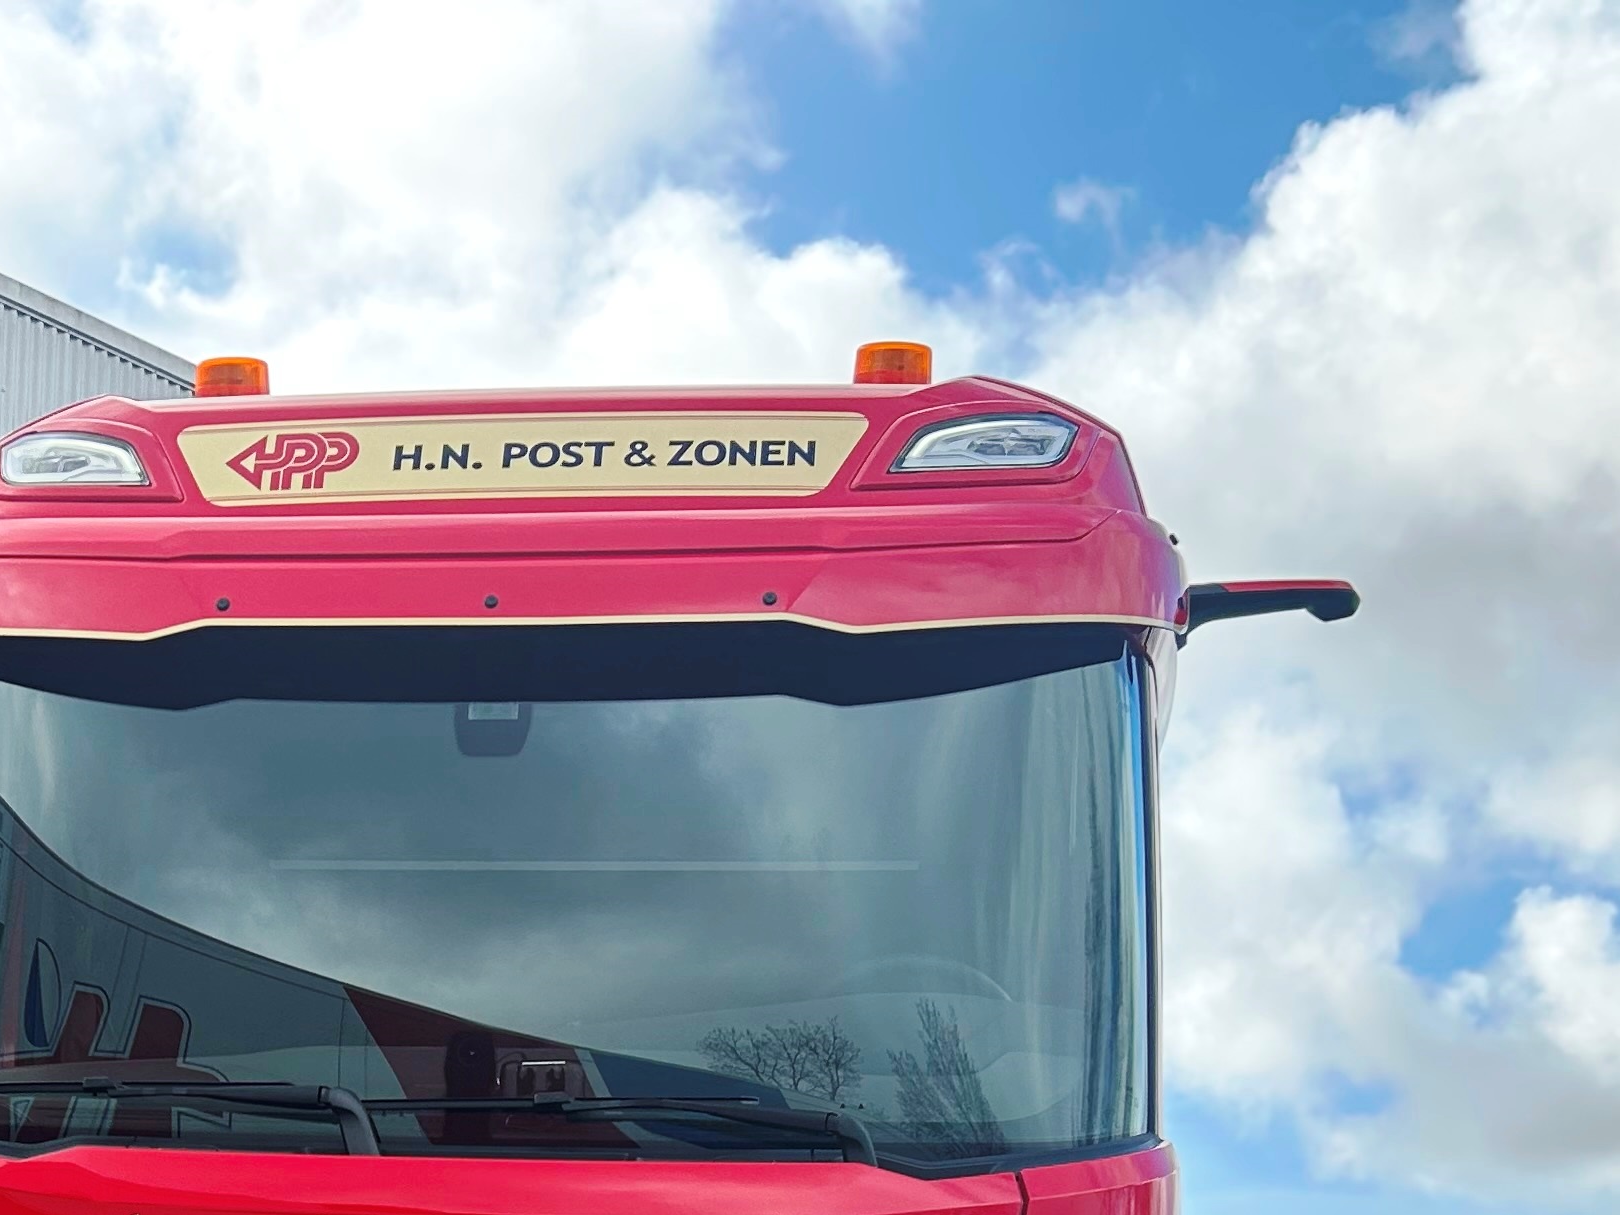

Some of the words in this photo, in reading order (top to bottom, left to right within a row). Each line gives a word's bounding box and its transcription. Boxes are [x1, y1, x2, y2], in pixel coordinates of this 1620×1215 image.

[391, 442, 482, 471] H.N.
[502, 441, 614, 468] POST
[623, 440, 656, 467] &
[668, 440, 817, 467] ZONEN
